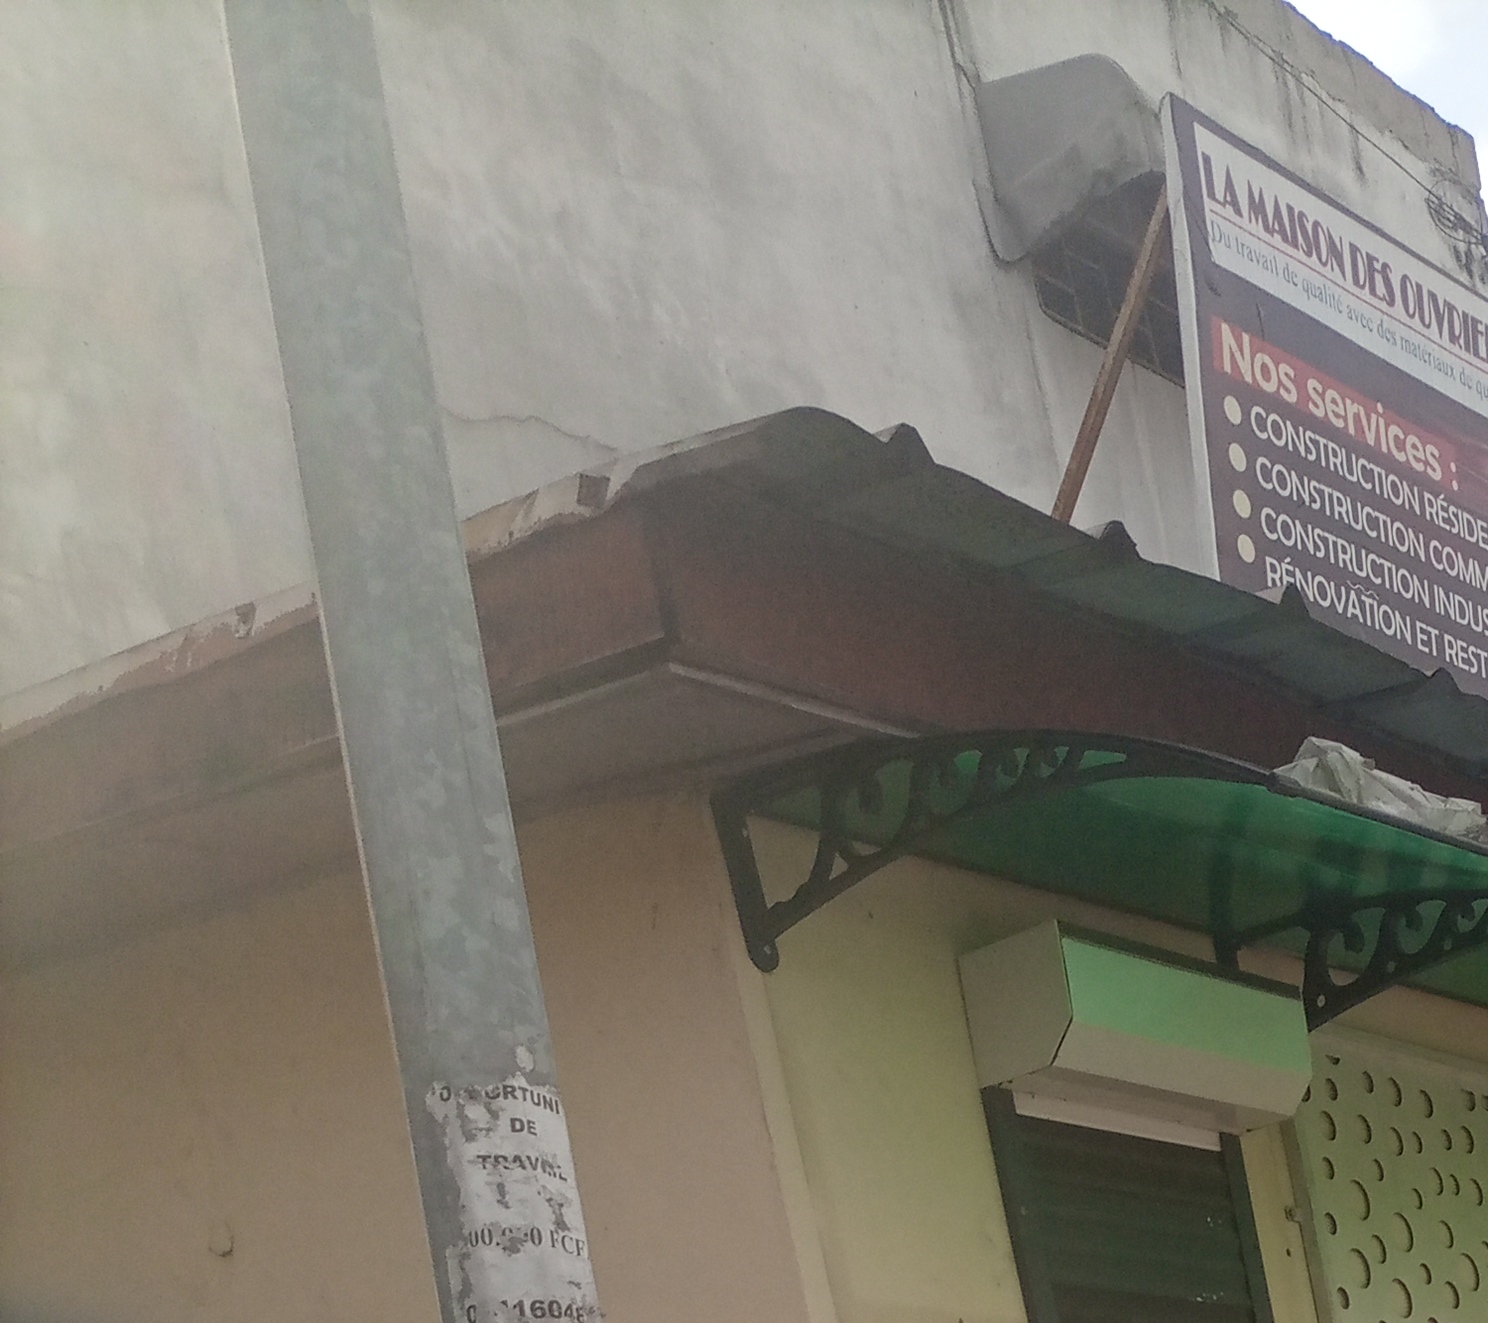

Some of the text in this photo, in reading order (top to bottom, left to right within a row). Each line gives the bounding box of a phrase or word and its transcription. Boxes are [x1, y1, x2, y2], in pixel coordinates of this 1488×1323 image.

[1201, 151, 1243, 218] LA
[1247, 179, 1347, 282] MAISON
[1349, 240, 1396, 308] DES
[1210, 219, 1232, 249] Du
[1235, 236, 1279, 276] travail
[1282, 263, 1298, 287] de
[1302, 277, 1344, 315] qualité
[1347, 307, 1373, 332] avec
[1377, 319, 1398, 346] des
[1400, 335, 1456, 381] matériaux
[1459, 366, 1473, 390] de
[1221, 322, 1298, 404] Nos
[1308, 377, 1443, 481] services
[1251, 405, 1421, 515] CONSTRUCTION
[1256, 456, 1425, 562] CONSTRUCTION
[1260, 507, 1430, 606] CONSTRUCTION
[1266, 556, 1412, 645] RÉNOVATION
[1416, 624, 1439, 656] ET
[510, 1117, 538, 1136] DE
